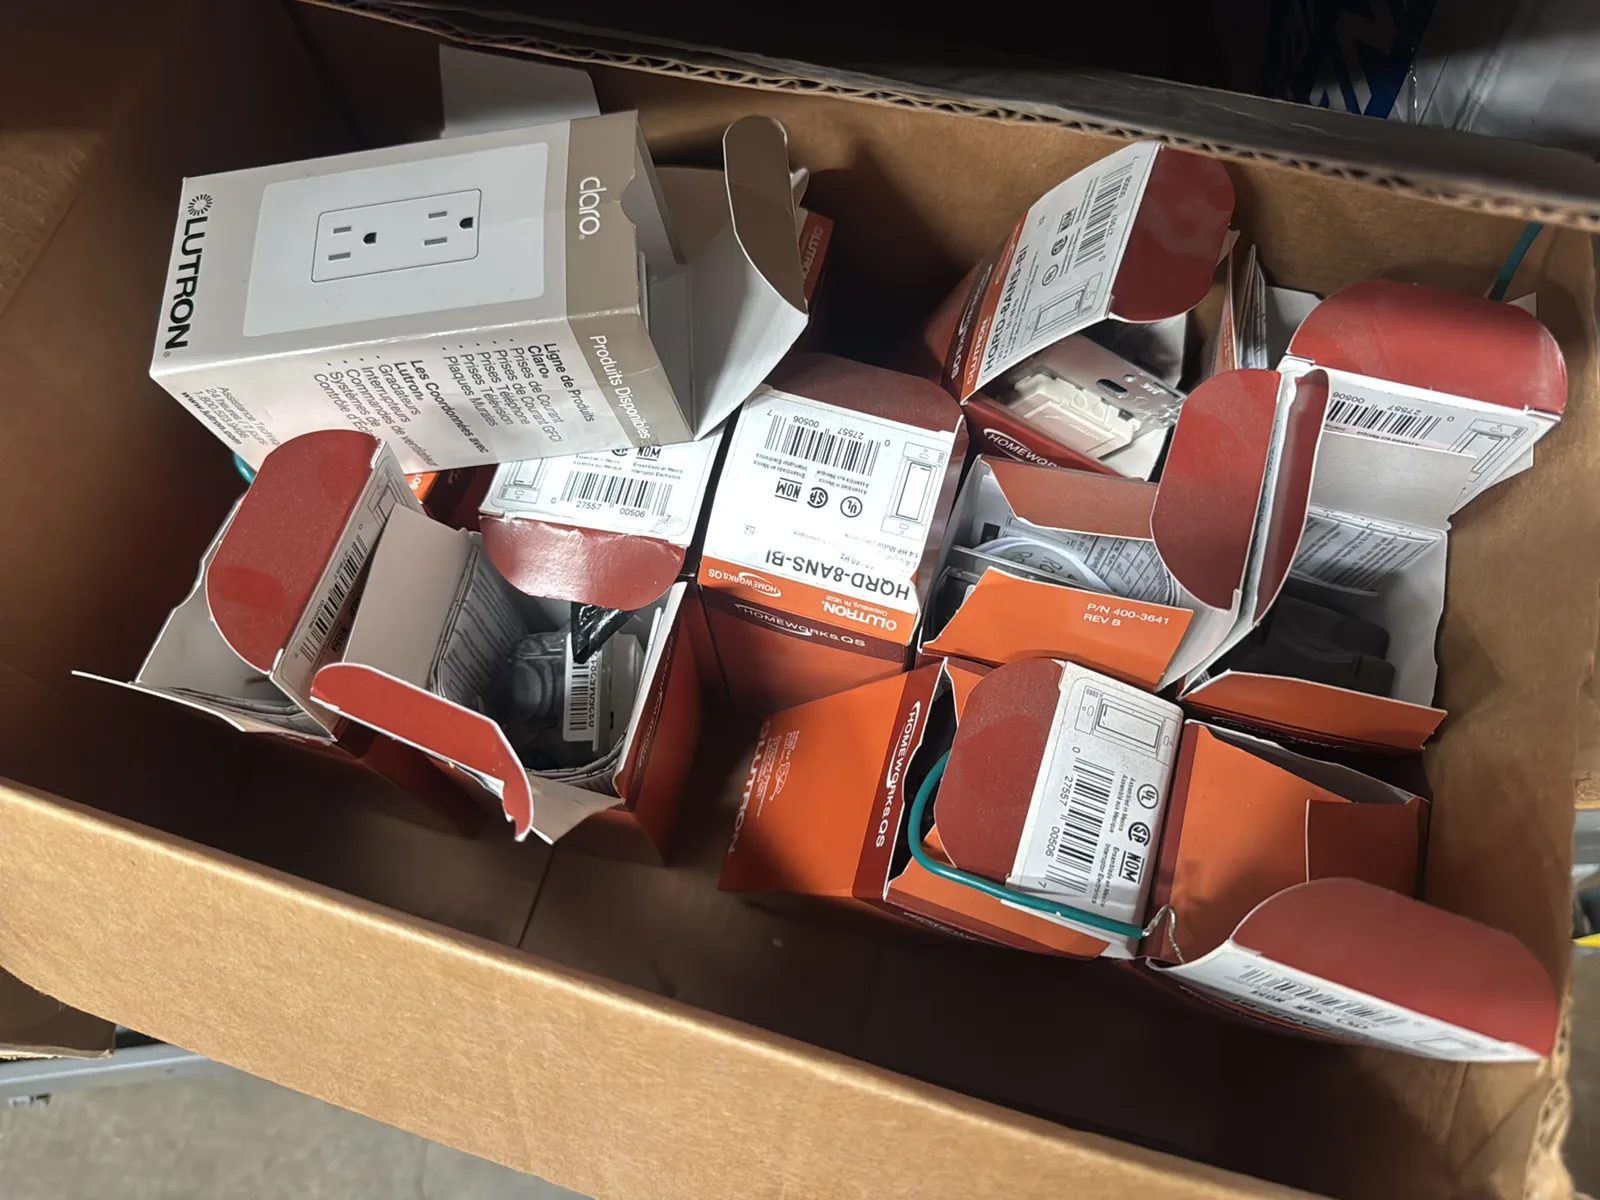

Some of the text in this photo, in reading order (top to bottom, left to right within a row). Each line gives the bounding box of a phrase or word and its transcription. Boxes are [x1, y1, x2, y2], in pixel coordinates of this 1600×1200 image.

[984, 244, 1029, 372] HQRD-8ANS-BI
[205, 388, 217, 399] 24
[215, 396, 242, 422] heures
[217, 385, 256, 422] Assistance
[314, 373, 351, 413] Contrôle
[329, 371, 381, 428] Systèmes de
[360, 366, 411, 424] Interrupteurs
[378, 364, 422, 416] Gradateurs
[410, 359, 490, 454] Les Coordonnées avec
[443, 355, 499, 427] Plaques Murales
[460, 353, 514, 426] Prises Télévision
[476, 351, 531, 426] Prises Téléphone
[493, 349, 564, 443] Prises de Courant GFCI
[510, 347, 566, 424] Prises de Courant
[544, 343, 595, 423] Ligne de Produits
[589, 335, 651, 440] Produits Disponibles
[180, 391, 242, 445] www.lutron.com
[346, 368, 439, 467] Commandes de ventilateur
[792, 415, 820, 428] 00506
[837, 427, 865, 440] 27557
[884, 438, 891, 447] 0
[550, 496, 557, 504] 0
[576, 501, 602, 511] 27557
[619, 507, 646, 519] 00506
[775, 480, 803, 499] NOM
[765, 548, 910, 601] HQRD-8ANS-BI
[851, 600, 889, 617] Coopersburg,
[1083, 613, 1122, 627] REV B
[1086, 602, 1170, 625] P/N 400-3641
[1037, 746, 1081, 889] 0 27557 00506 7
[1122, 852, 1141, 883] NOM
